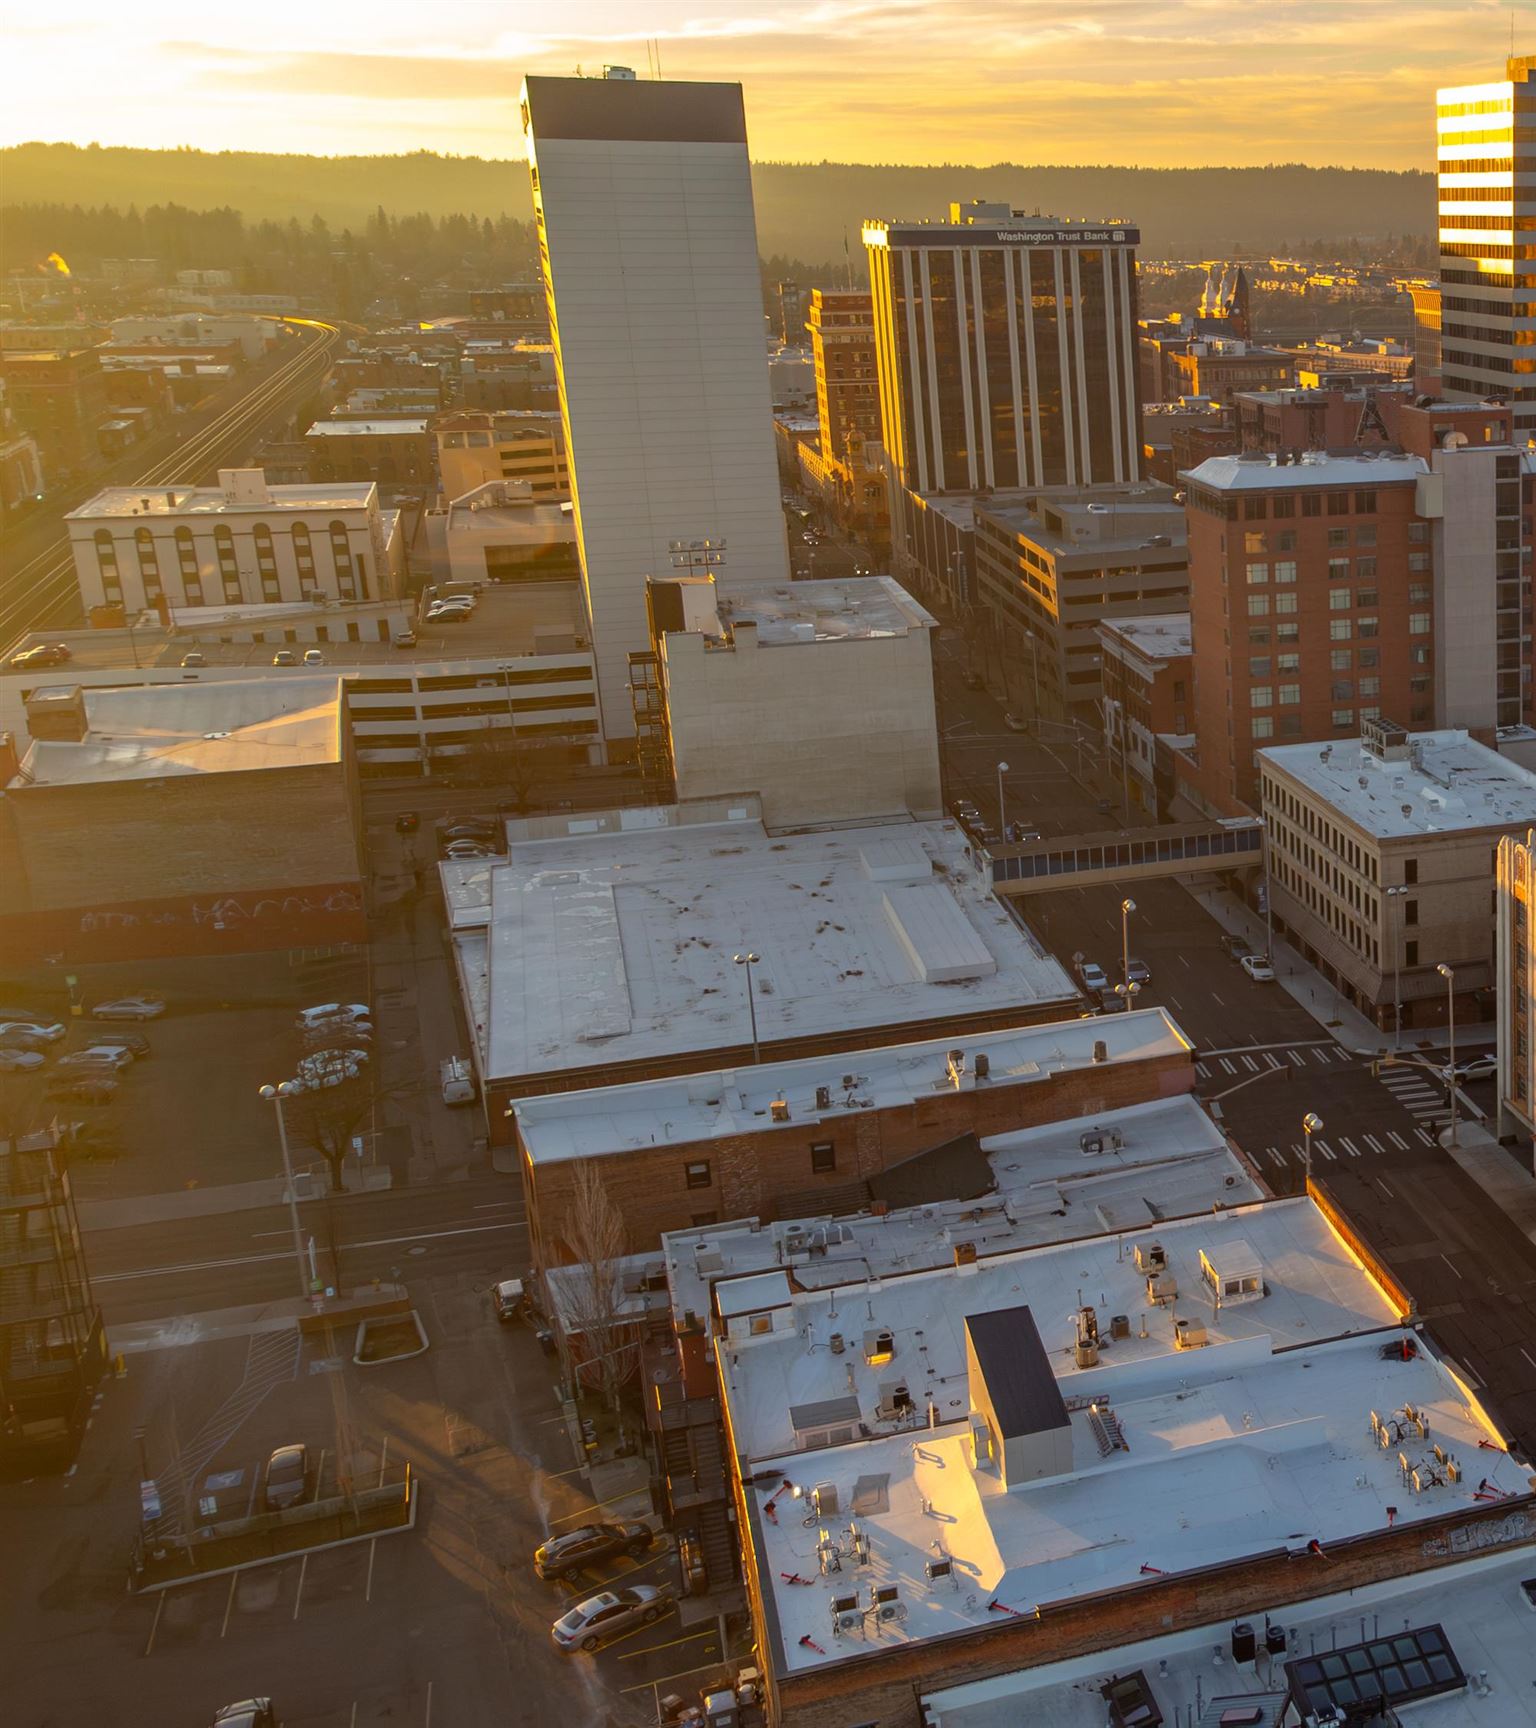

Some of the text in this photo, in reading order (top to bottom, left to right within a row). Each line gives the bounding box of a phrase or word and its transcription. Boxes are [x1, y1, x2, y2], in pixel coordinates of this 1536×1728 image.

[997, 231, 1110, 245] Washington Trust Bank
